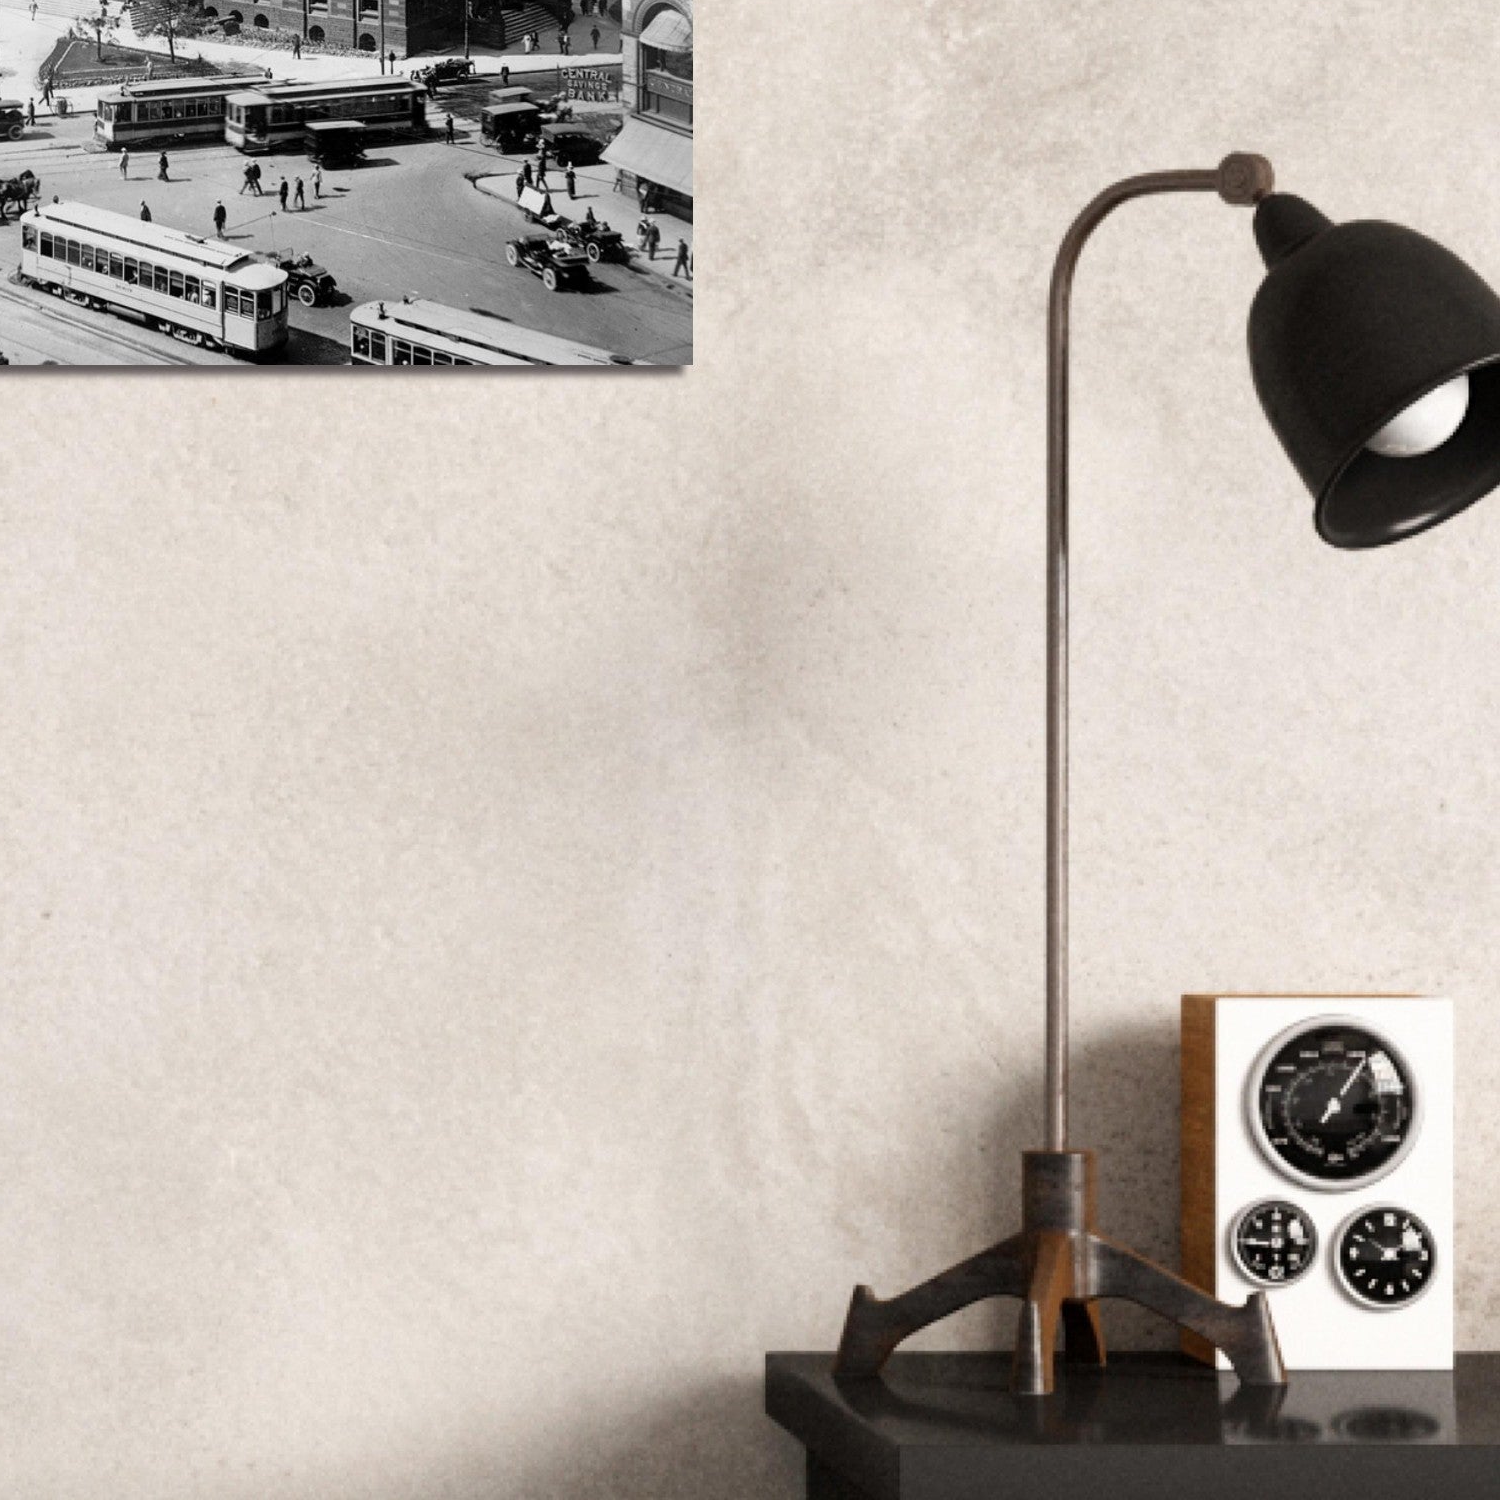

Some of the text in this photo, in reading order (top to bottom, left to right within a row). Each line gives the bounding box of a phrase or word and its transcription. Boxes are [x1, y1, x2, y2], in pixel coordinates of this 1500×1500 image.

[561, 67, 612, 83] CENTRAL
[567, 80, 608, 90] SAVINGS
[567, 88, 609, 102] BANK
